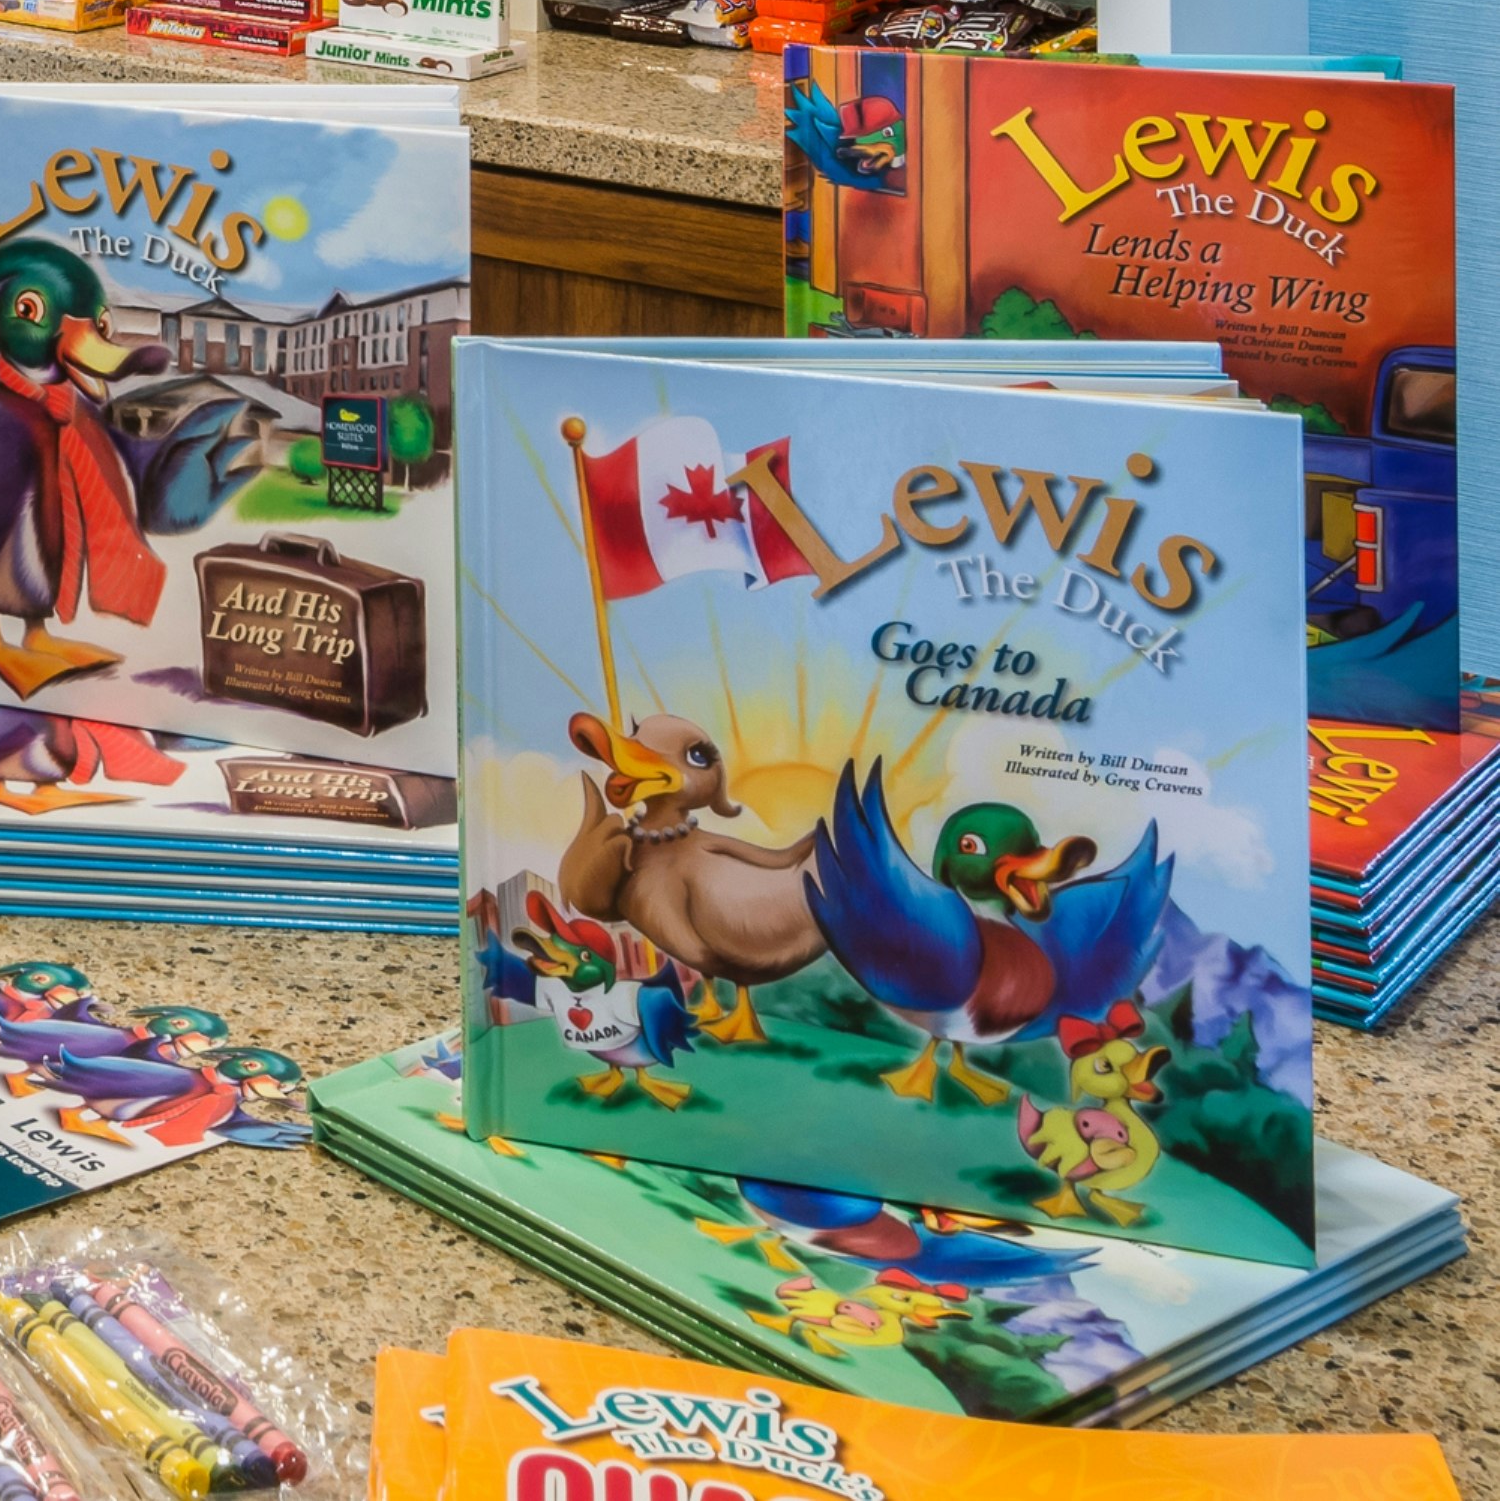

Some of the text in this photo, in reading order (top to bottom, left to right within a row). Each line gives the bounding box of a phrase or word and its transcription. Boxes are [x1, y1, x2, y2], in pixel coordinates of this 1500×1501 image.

[315, 41, 410, 67] Junior Mints
[991, 105, 1380, 223] Lewis
[1083, 222, 1222, 264] Lends a
[1156, 184, 1347, 267] The Duck
[69, 225, 227, 295] The Duck
[1109, 264, 1370, 324] Helping Wing
[1242, 336, 1295, 349] Christian
[1298, 340, 1343, 353] Duncan
[725, 448, 1218, 612] Lewis
[219, 582, 342, 624] And His
[933, 555, 1187, 673] The Duck
[207, 611, 355, 664] Long Trip
[868, 620, 1037, 678] Goes to
[225, 676, 352, 704] Illustrated by Greg Cravens
[234, 663, 342, 688] Written by Bill Duncan
[904, 663, 1093, 726] Canada
[1004, 760, 1203, 796] Illustrated by Greg Cravens
[1019, 744, 1188, 776] Written by Bill Duncan
[235, 781, 389, 803] Long Trip
[563, 1024, 623, 1043] CANADA
[10, 1116, 106, 1172] Lewis
[10, 1139, 40, 1162] The
[7, 1154, 40, 1177] Long
[35, 1172, 63, 1188] Trip
[494, 1377, 836, 1461] Lewis
[617, 1431, 713, 1460] The
